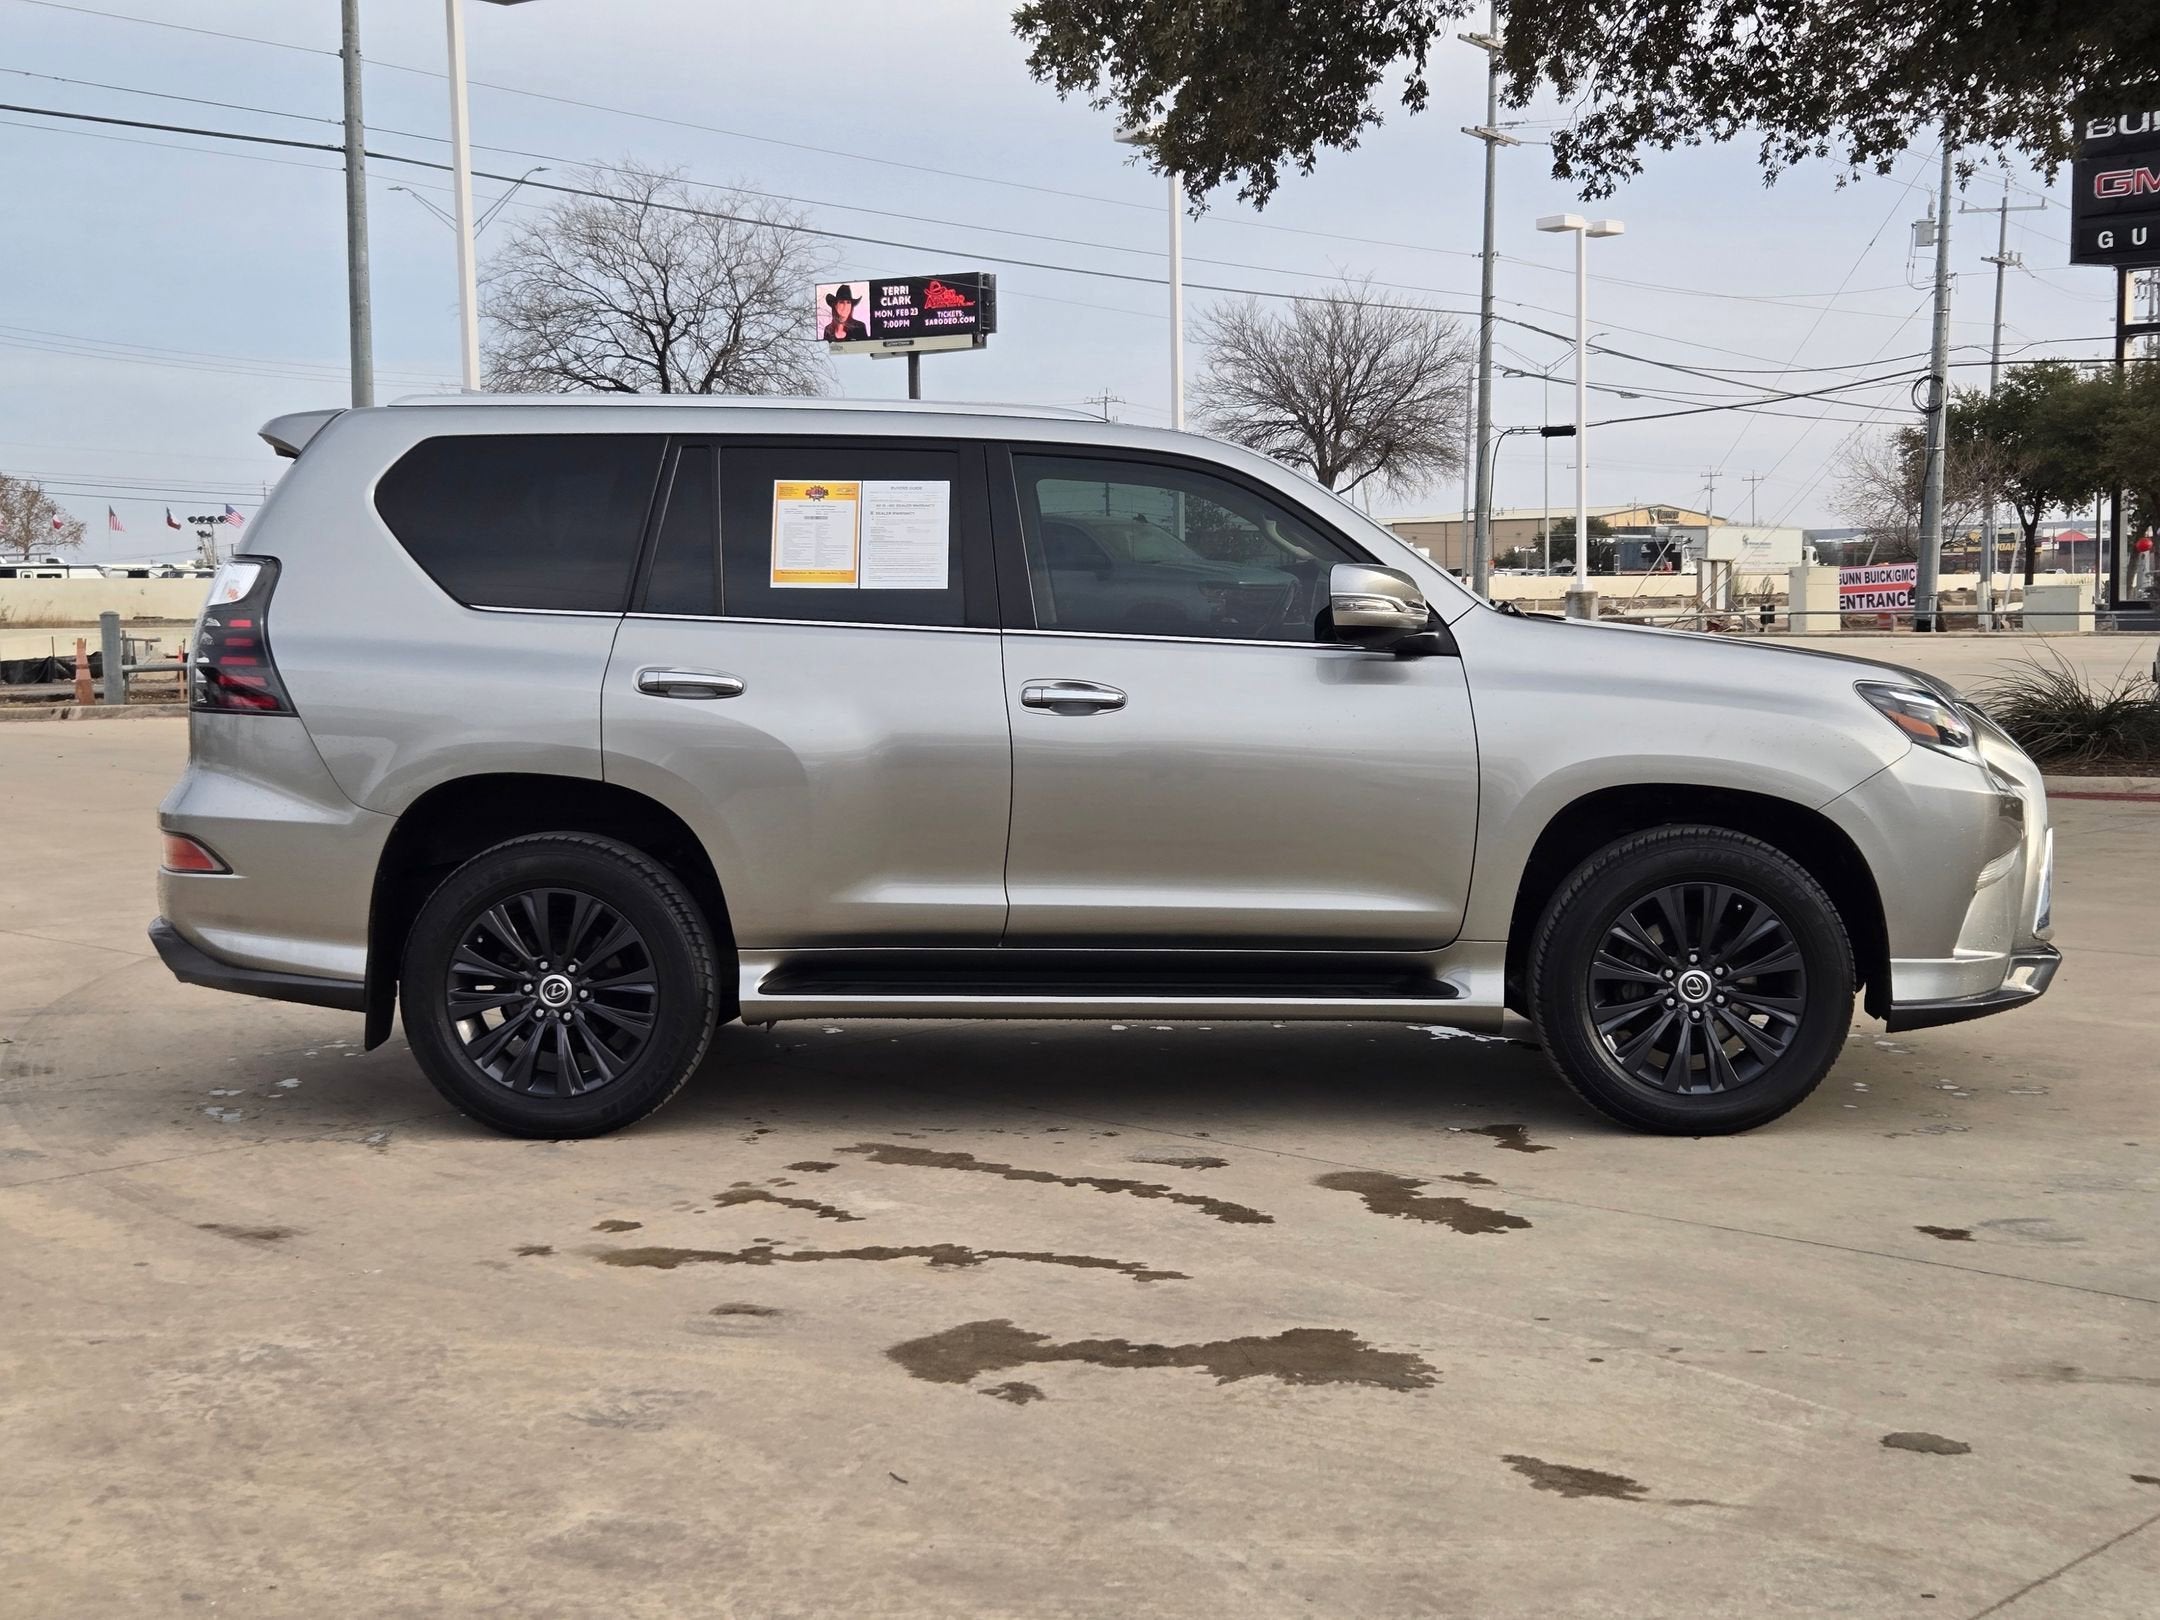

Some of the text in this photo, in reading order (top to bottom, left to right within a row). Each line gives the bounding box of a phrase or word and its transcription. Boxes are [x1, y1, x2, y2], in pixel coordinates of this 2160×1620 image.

[881, 285, 909, 296] TERRI
[880, 295, 911, 307] CLARK
[874, 307, 919, 318] MON, FEB 23
[883, 319, 910, 328] 7:00PM
[925, 316, 976, 326] SARODEO.COM
[1839, 591, 1916, 610] ENTRANCE
